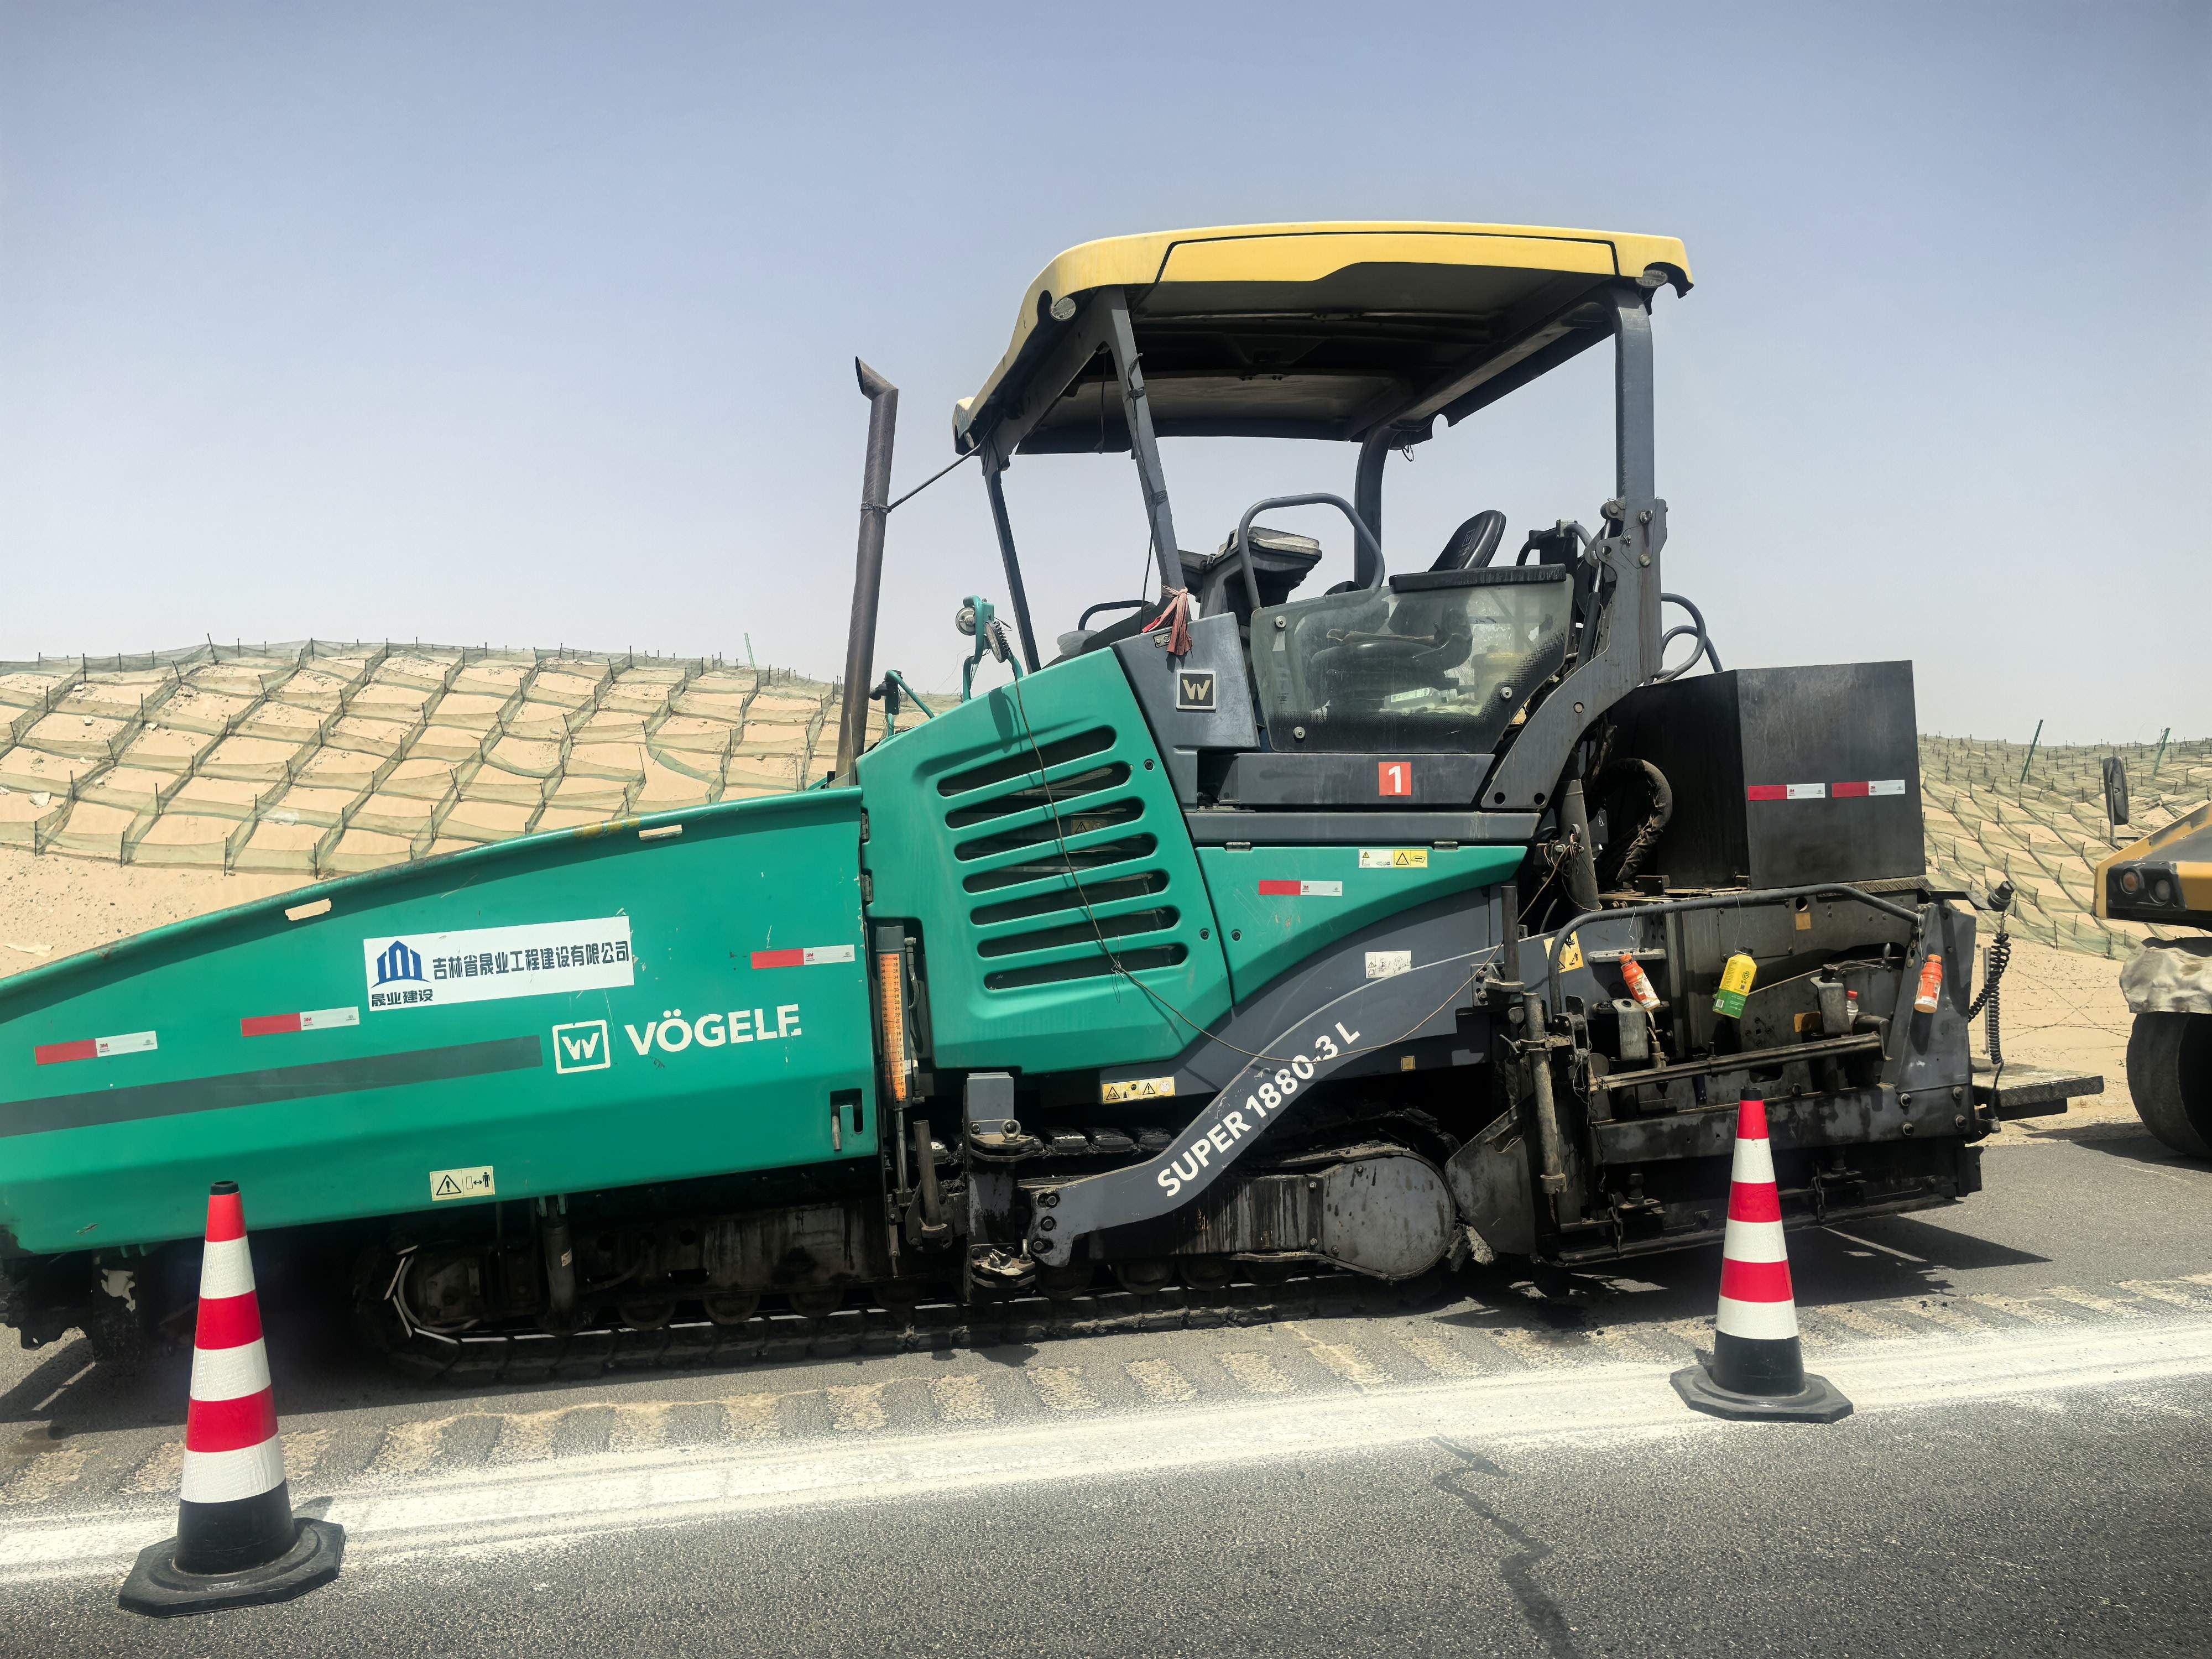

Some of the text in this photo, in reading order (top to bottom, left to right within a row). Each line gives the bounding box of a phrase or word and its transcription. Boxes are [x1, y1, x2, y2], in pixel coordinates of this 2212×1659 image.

[1389, 765, 1401, 793] 1
[432, 941, 630, 980] 吉林省晟业工程建设有限公司
[371, 988, 434, 1007] 晟业建设
[624, 1004, 802, 1056] VÖGELE
[1157, 1110, 1252, 1197] SUPER
[1334, 1021, 1361, 1045] L
